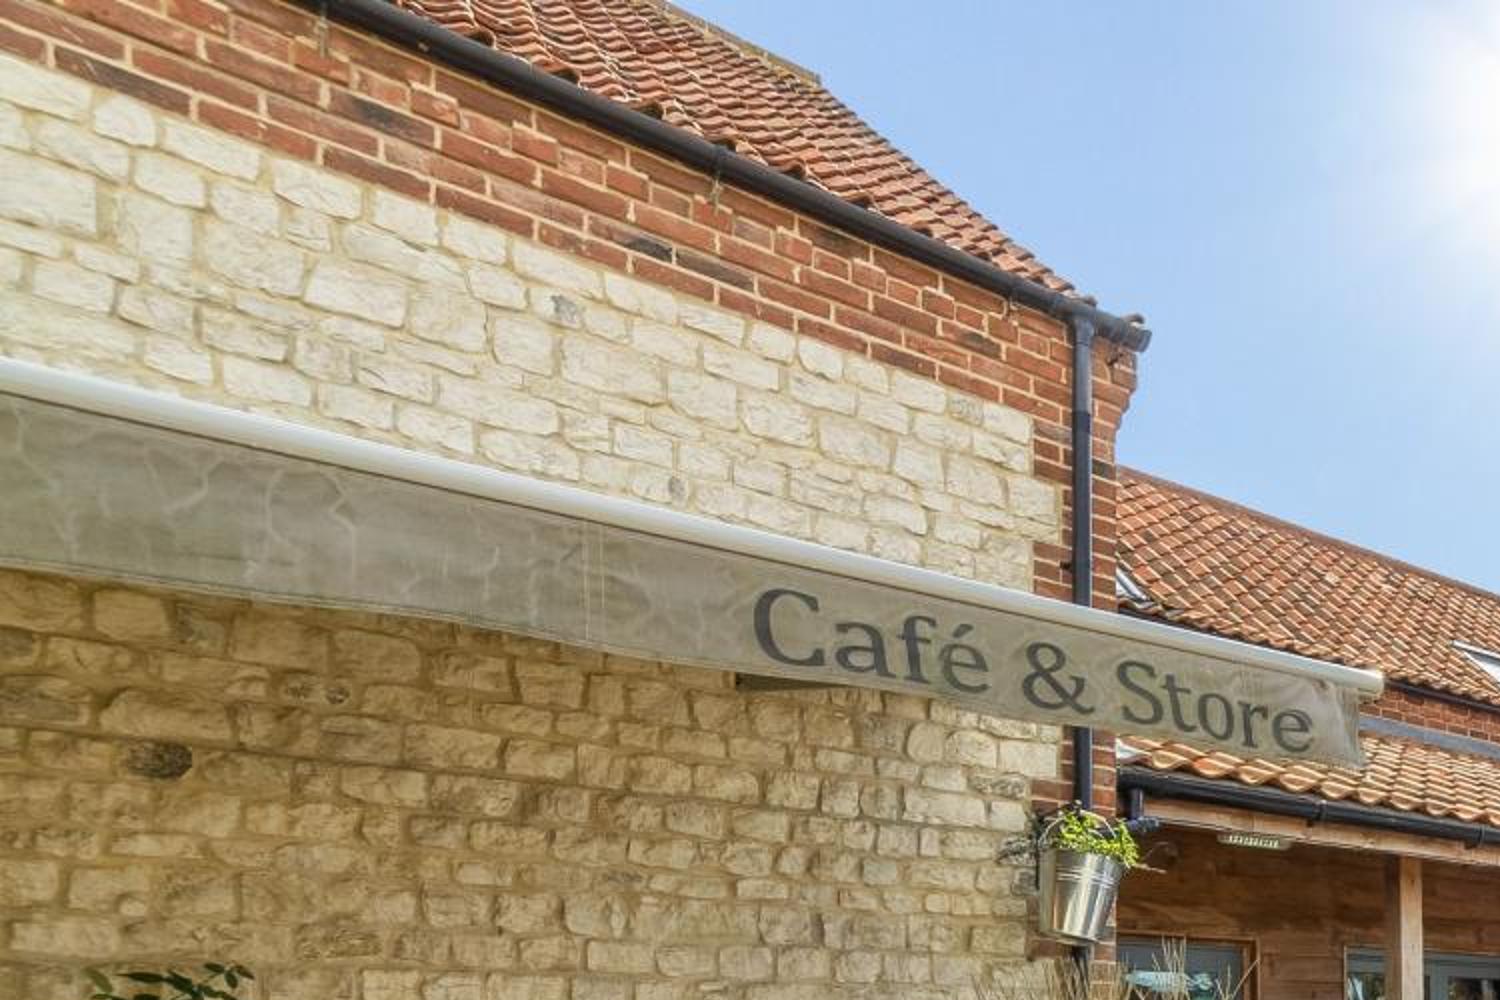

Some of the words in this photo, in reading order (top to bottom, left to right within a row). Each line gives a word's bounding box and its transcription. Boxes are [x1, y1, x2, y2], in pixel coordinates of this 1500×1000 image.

[753, 588, 990, 694] Café
[1022, 642, 1094, 714] &
[1116, 660, 1314, 752] Store
